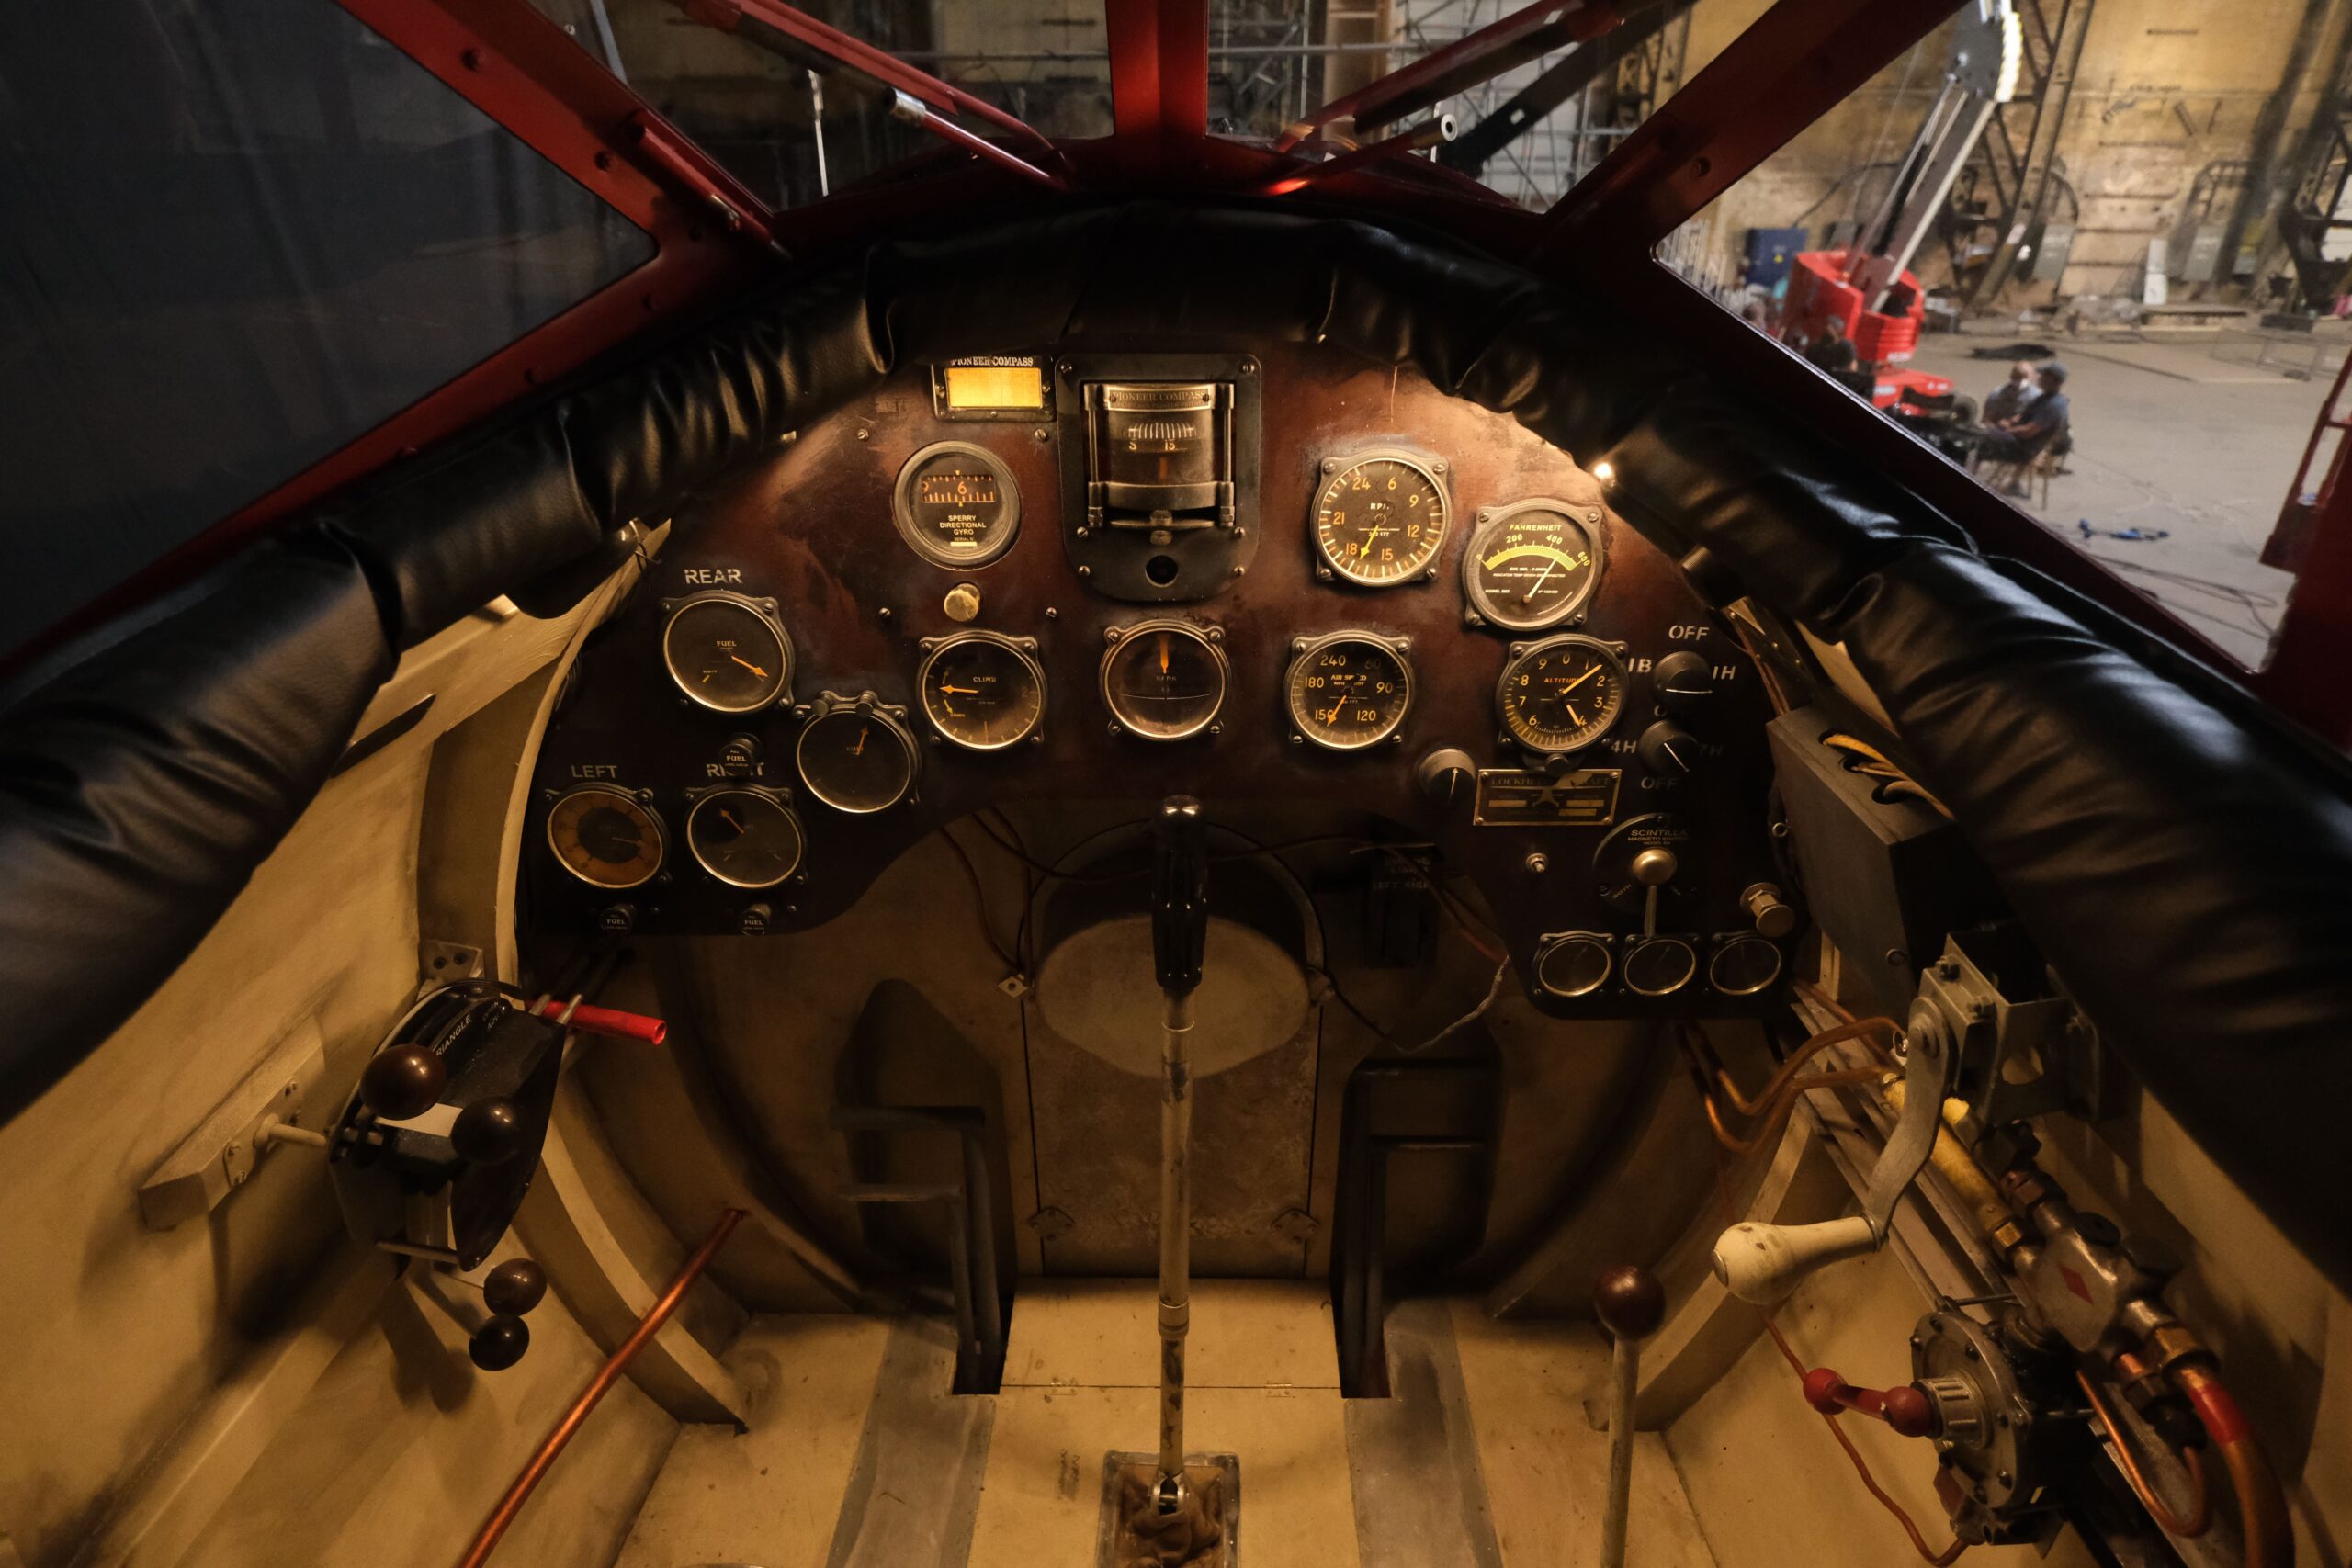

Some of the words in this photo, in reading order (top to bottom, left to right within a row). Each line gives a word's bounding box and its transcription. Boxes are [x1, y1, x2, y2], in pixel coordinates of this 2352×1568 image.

[992, 356, 1034, 367] COMPASS
[1113, 391, 1157, 402] PIONEER
[1159, 390, 1205, 401] COMPASS
[957, 480, 967, 495] 6
[1351, 477, 1372, 491] 24
[1387, 478, 1397, 490] 6
[1409, 494, 1419, 507] 9
[1333, 512, 1345, 525] 21
[1407, 525, 1420, 538] 12
[1506, 534, 1523, 544] 200
[1545, 534, 1563, 545] 400
[1346, 543, 1358, 556] 18
[1381, 548, 1394, 561] 15
[1577, 551, 1591, 567] 600
[684, 569, 743, 584] REAR
[1668, 624, 1710, 641] OFF
[1320, 654, 1347, 666] 240
[1364, 659, 1382, 670] 60
[1538, 659, 1548, 670] 9
[1562, 653, 1571, 665] 0
[1305, 676, 1325, 688] 180
[1520, 674, 1530, 686] 8
[1596, 675, 1606, 687] 2
[1375, 682, 1394, 694] 90
[1519, 695, 1527, 707] 7
[1594, 696, 1603, 708] 3
[1356, 709, 1376, 721] 120
[1528, 715, 1537, 726] 6
[1610, 739, 1638, 754] 4H
[1698, 744, 1724, 757] 7H
[571, 764, 617, 779] LEFT
[706, 761, 765, 778] RIT
[1492, 777, 1551, 786] LOCKHE
[1640, 776, 1679, 790] OFF
[436, 1012, 471, 1056] RIANGLE
